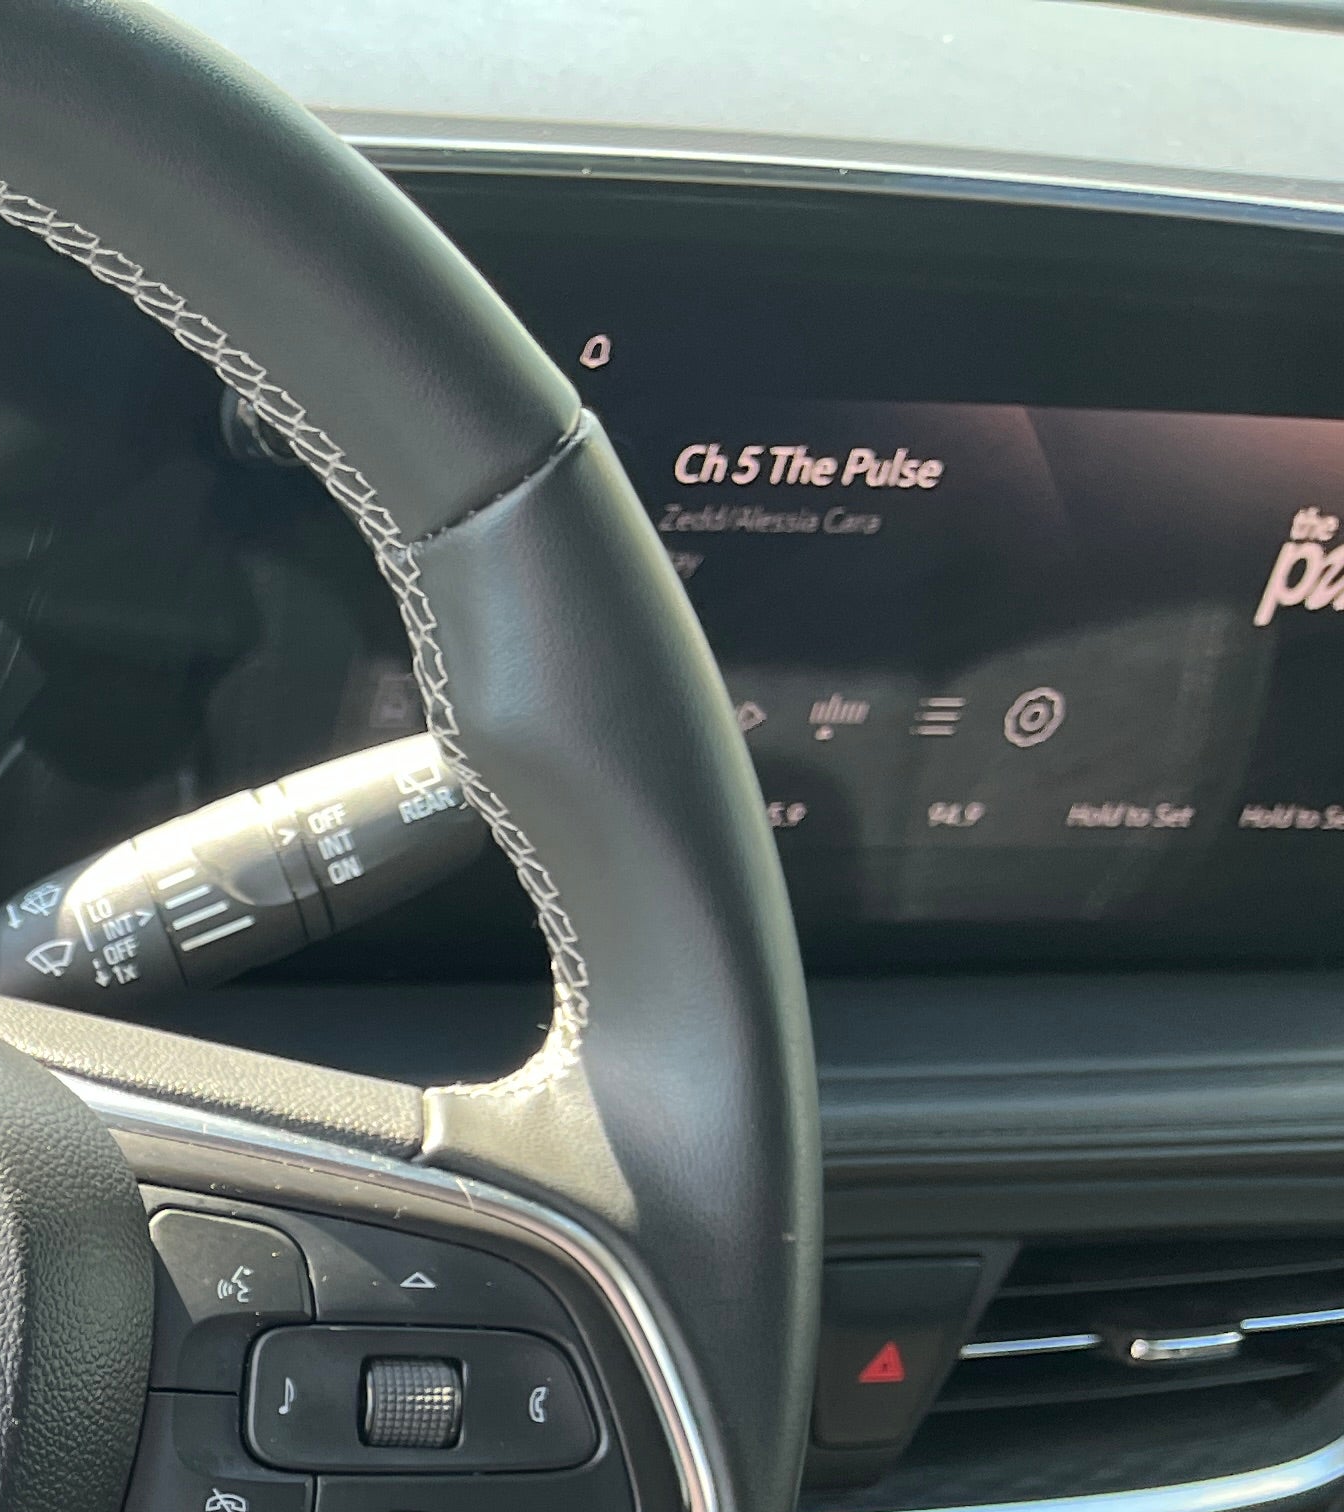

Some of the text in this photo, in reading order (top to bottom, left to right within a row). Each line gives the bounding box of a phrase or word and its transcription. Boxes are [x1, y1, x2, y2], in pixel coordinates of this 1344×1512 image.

[674, 443, 945, 489] Ch 5 The Pulse
[307, 802, 347, 835] OFF
[398, 785, 457, 824] REAR
[317, 827, 354, 860] INT
[327, 854, 363, 885] ON
[86, 898, 113, 923] LO
[102, 912, 136, 941] INT
[102, 935, 139, 966] OFF
